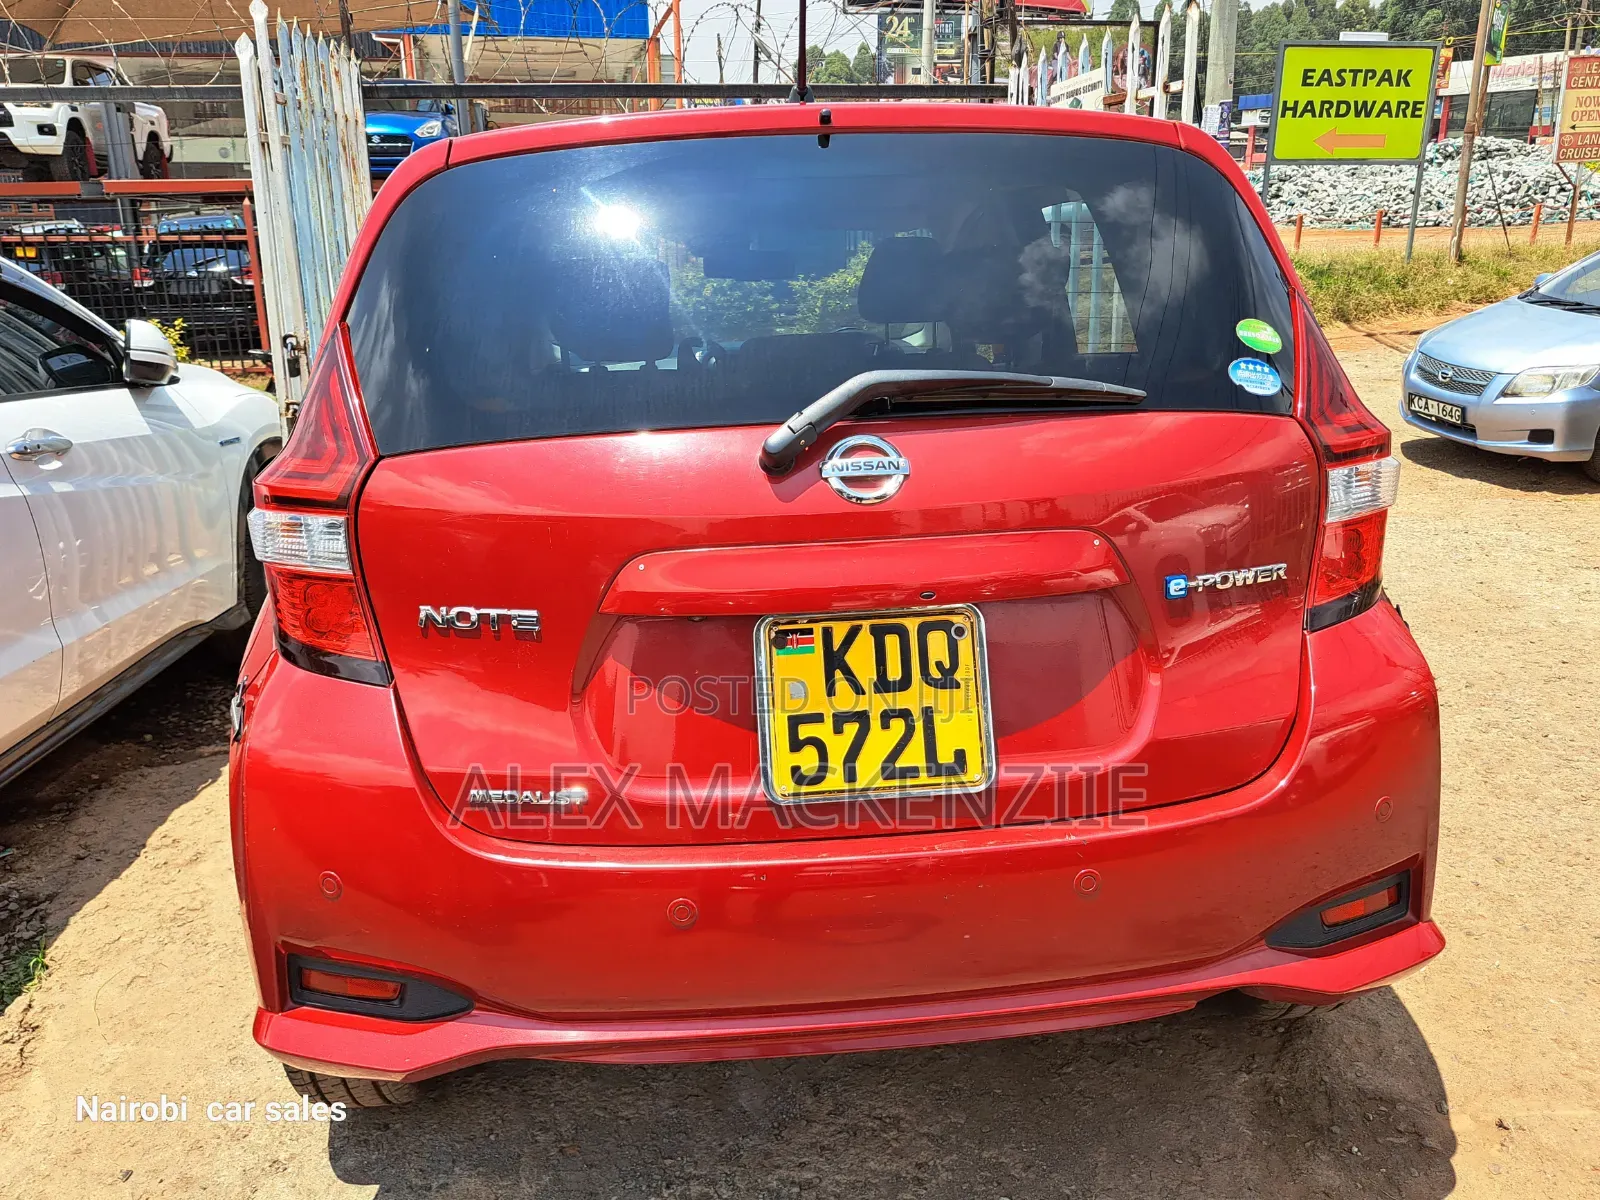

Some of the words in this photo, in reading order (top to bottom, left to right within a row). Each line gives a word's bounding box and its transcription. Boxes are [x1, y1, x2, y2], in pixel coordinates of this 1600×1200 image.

[1301, 68, 1413, 87] EASTPAK
[1586, 62, 1600, 74] LE
[1571, 76, 1600, 88] CENT
[1280, 100, 1425, 118] HARDWARE
[1577, 134, 1600, 146] LAN
[1410, 394, 1430, 412] KCA
[1436, 402, 1461, 422] 164G
[831, 460, 901, 472] NISSAN
[418, 605, 541, 631] NOTE
[822, 620, 961, 697] KDQ
[787, 706, 967, 786] 572L
[470, 787, 588, 806] MEDALIST
